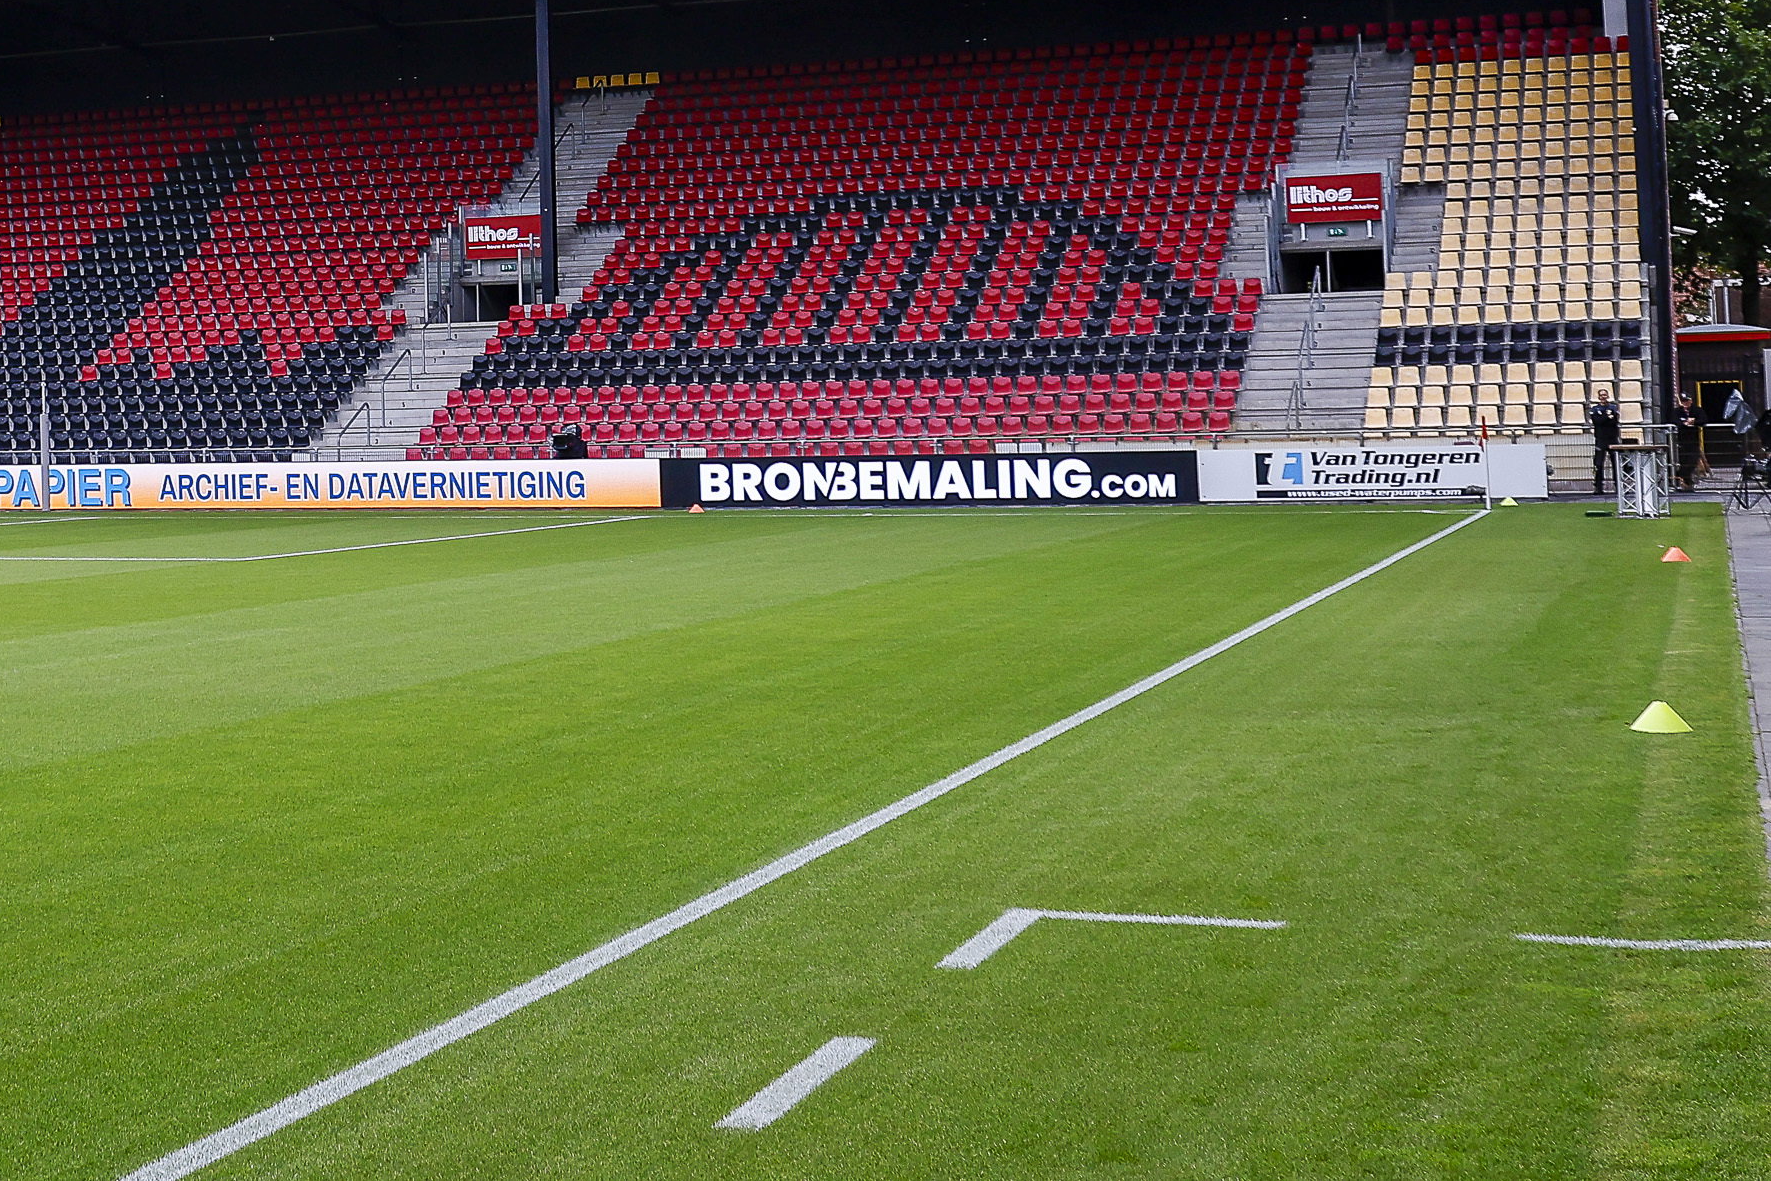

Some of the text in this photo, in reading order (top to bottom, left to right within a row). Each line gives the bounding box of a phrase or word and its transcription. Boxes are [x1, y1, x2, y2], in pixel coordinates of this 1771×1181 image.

[1289, 185, 1353, 204] lithos
[468, 225, 519, 243] lithos
[1310, 450, 1480, 471] Van Tongeren
[159, 470, 585, 501] ARCHIEF- EN DATAVERNIETIGING
[699, 458, 1177, 502] BRONBEMALING.COM
[1310, 468, 1440, 488] Trading.nl
[1287, 487, 1462, 499] www.used-waterpumps.com
